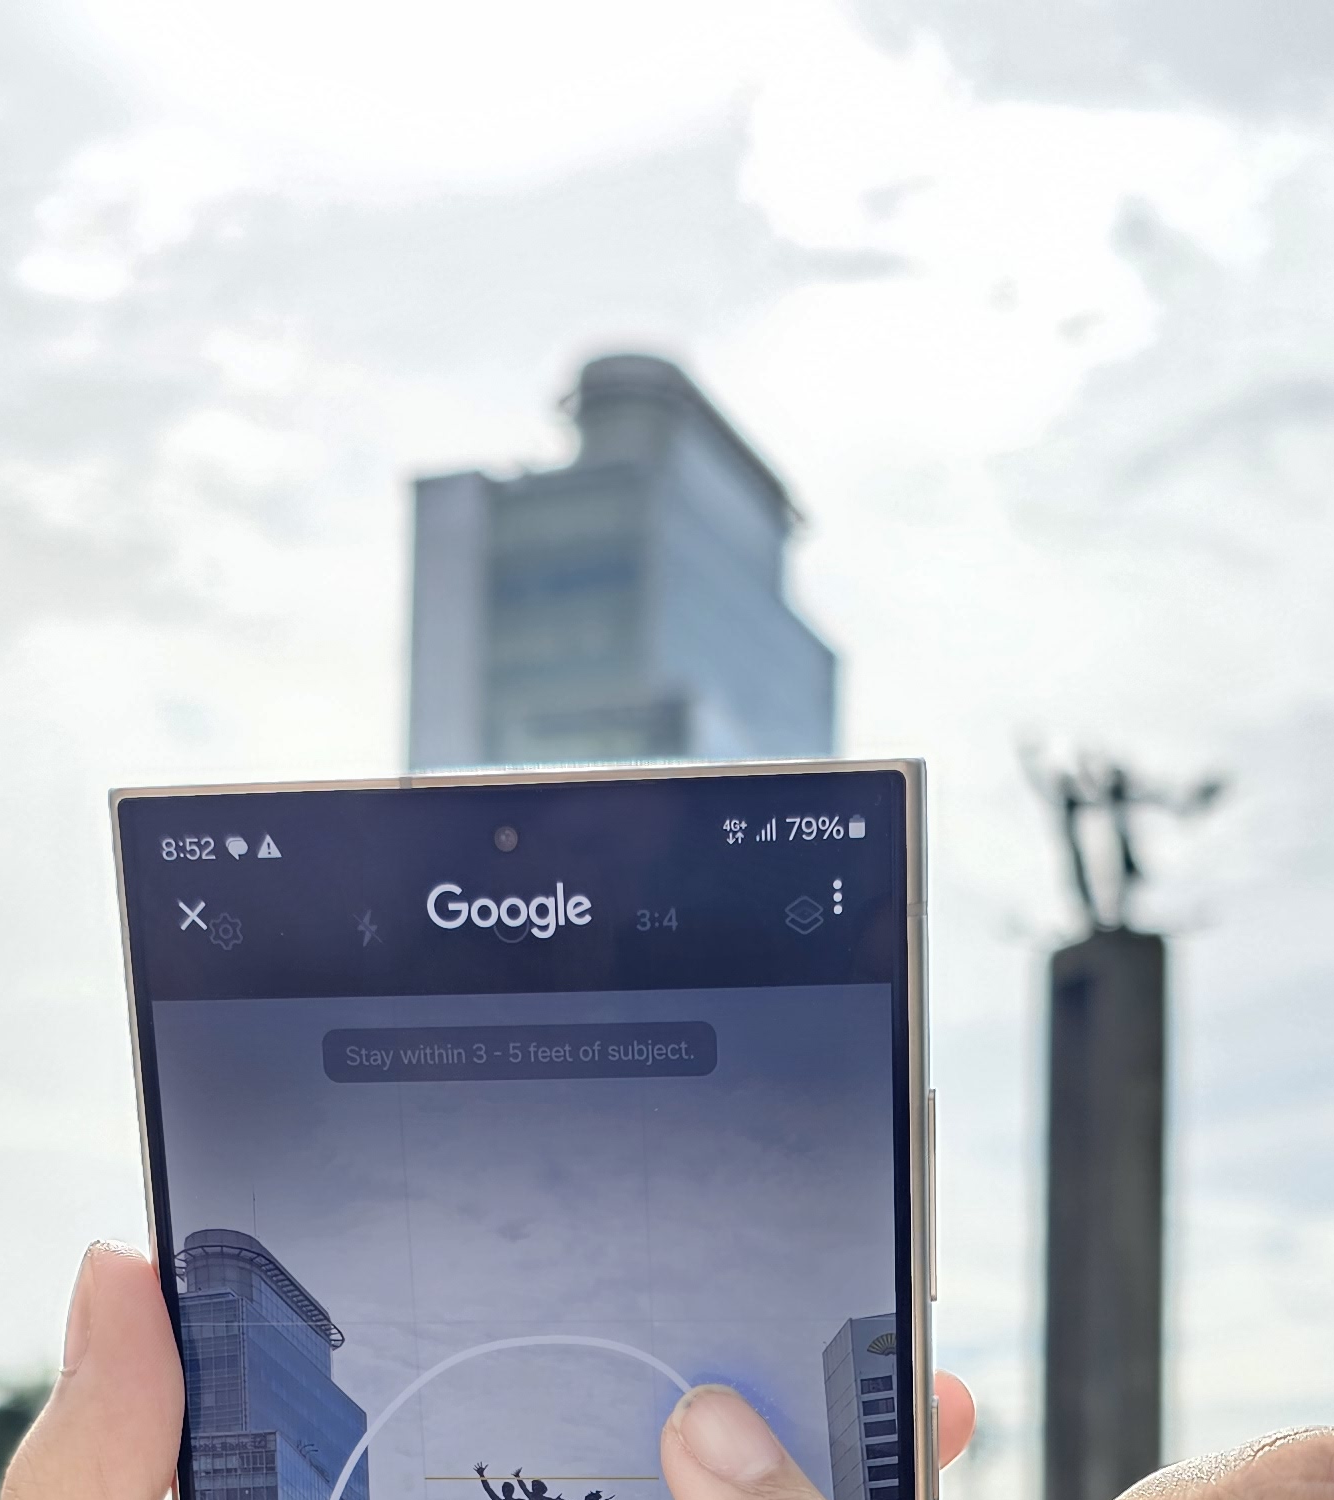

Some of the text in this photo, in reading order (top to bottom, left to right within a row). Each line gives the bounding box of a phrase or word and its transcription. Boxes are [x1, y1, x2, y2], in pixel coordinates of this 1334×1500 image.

[723, 816, 845, 841] 4G+ 79%
[161, 838, 216, 861] 8:52
[426, 881, 592, 939] Google
[635, 908, 679, 931] 3:4
[345, 1045, 394, 1070] Stay
[400, 1043, 466, 1064] within
[472, 1043, 487, 1063] 3
[508, 1042, 522, 1062] 5
[528, 1041, 572, 1062] feet
[579, 1040, 601, 1060] of
[607, 1038, 695, 1065] subject.
